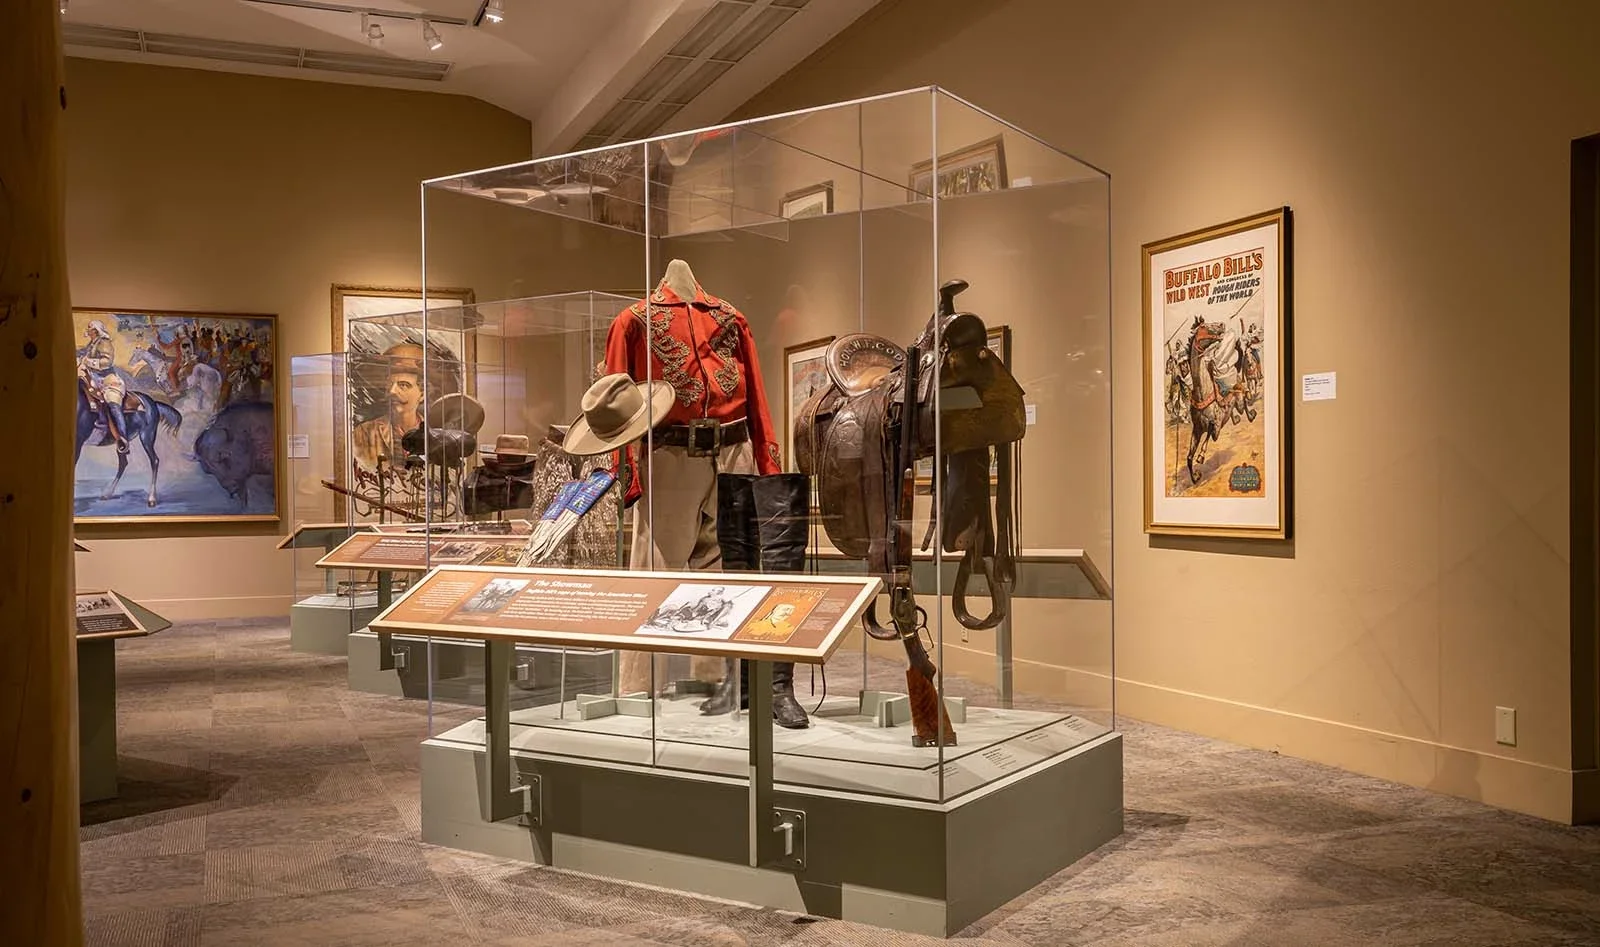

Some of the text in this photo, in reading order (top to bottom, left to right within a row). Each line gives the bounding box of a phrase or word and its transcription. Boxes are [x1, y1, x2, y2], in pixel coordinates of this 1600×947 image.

[1165, 253, 1263, 289] BUFFALO BILL'S
[1166, 283, 1211, 304] WILD WEST
[1212, 277, 1260, 295] ROUGH RIDERS
[1207, 289, 1253, 305] OF THE WORLD
